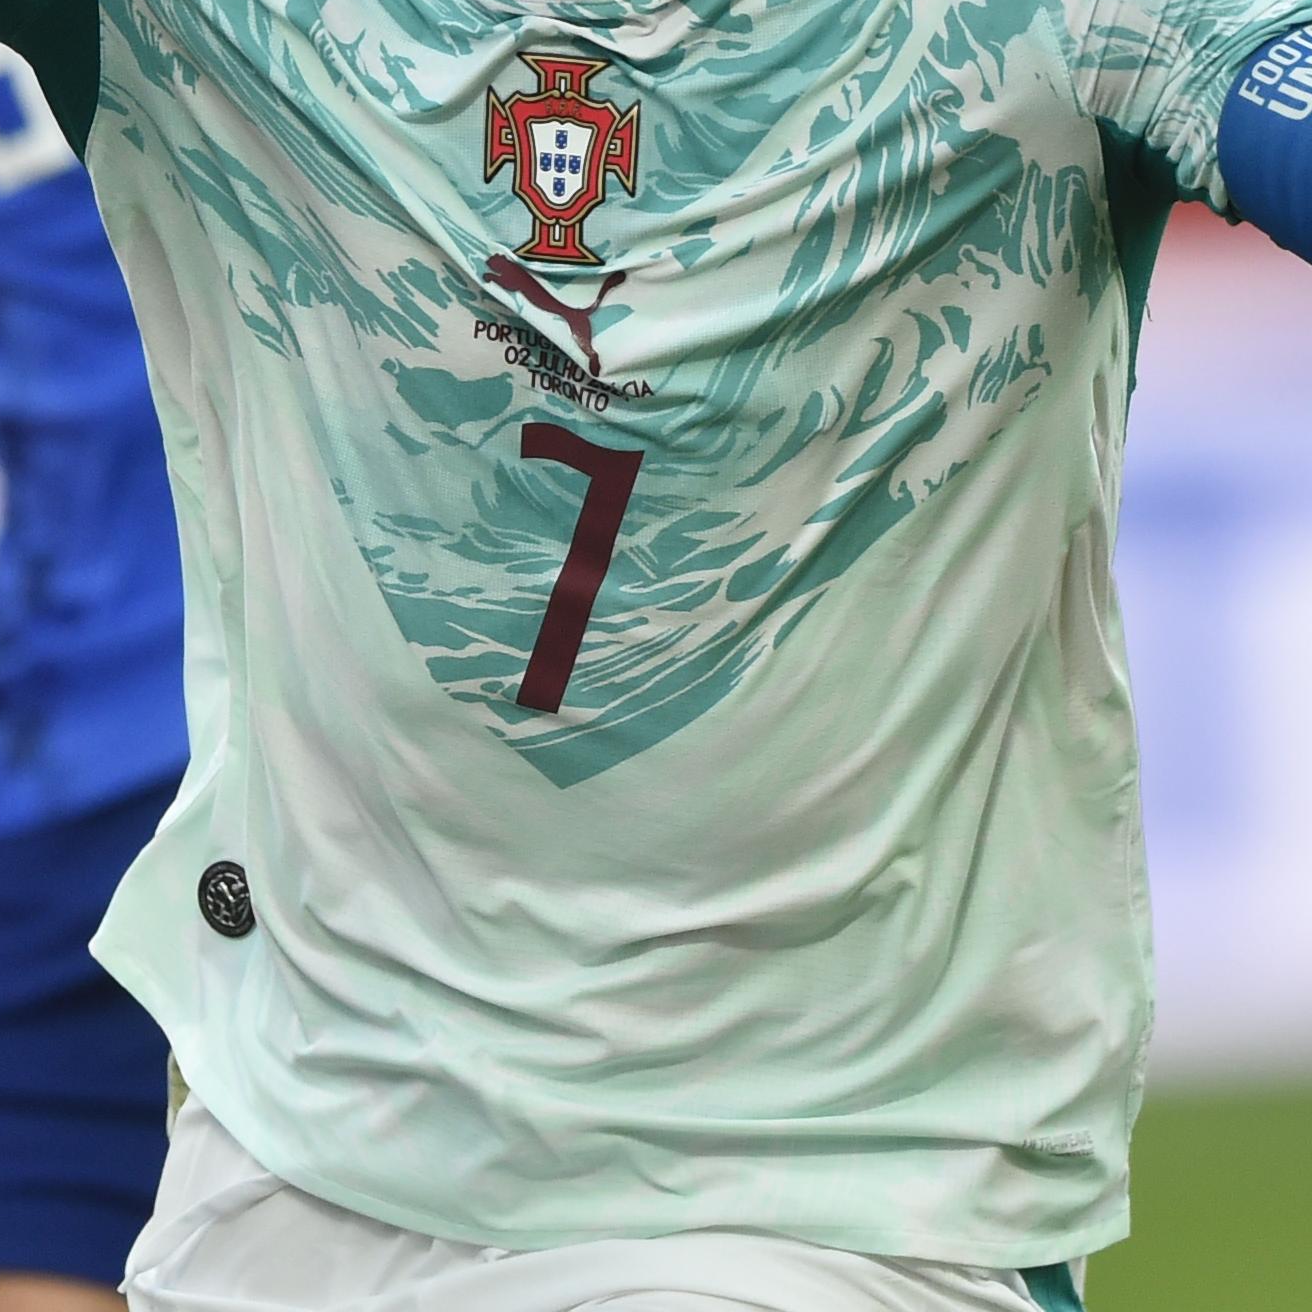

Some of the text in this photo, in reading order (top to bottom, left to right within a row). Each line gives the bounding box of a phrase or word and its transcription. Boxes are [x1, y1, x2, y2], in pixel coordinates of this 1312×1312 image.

[504, 346, 585, 382] 02 JULHO
[528, 369, 609, 412] TORONTO
[516, 422, 645, 714] 7
